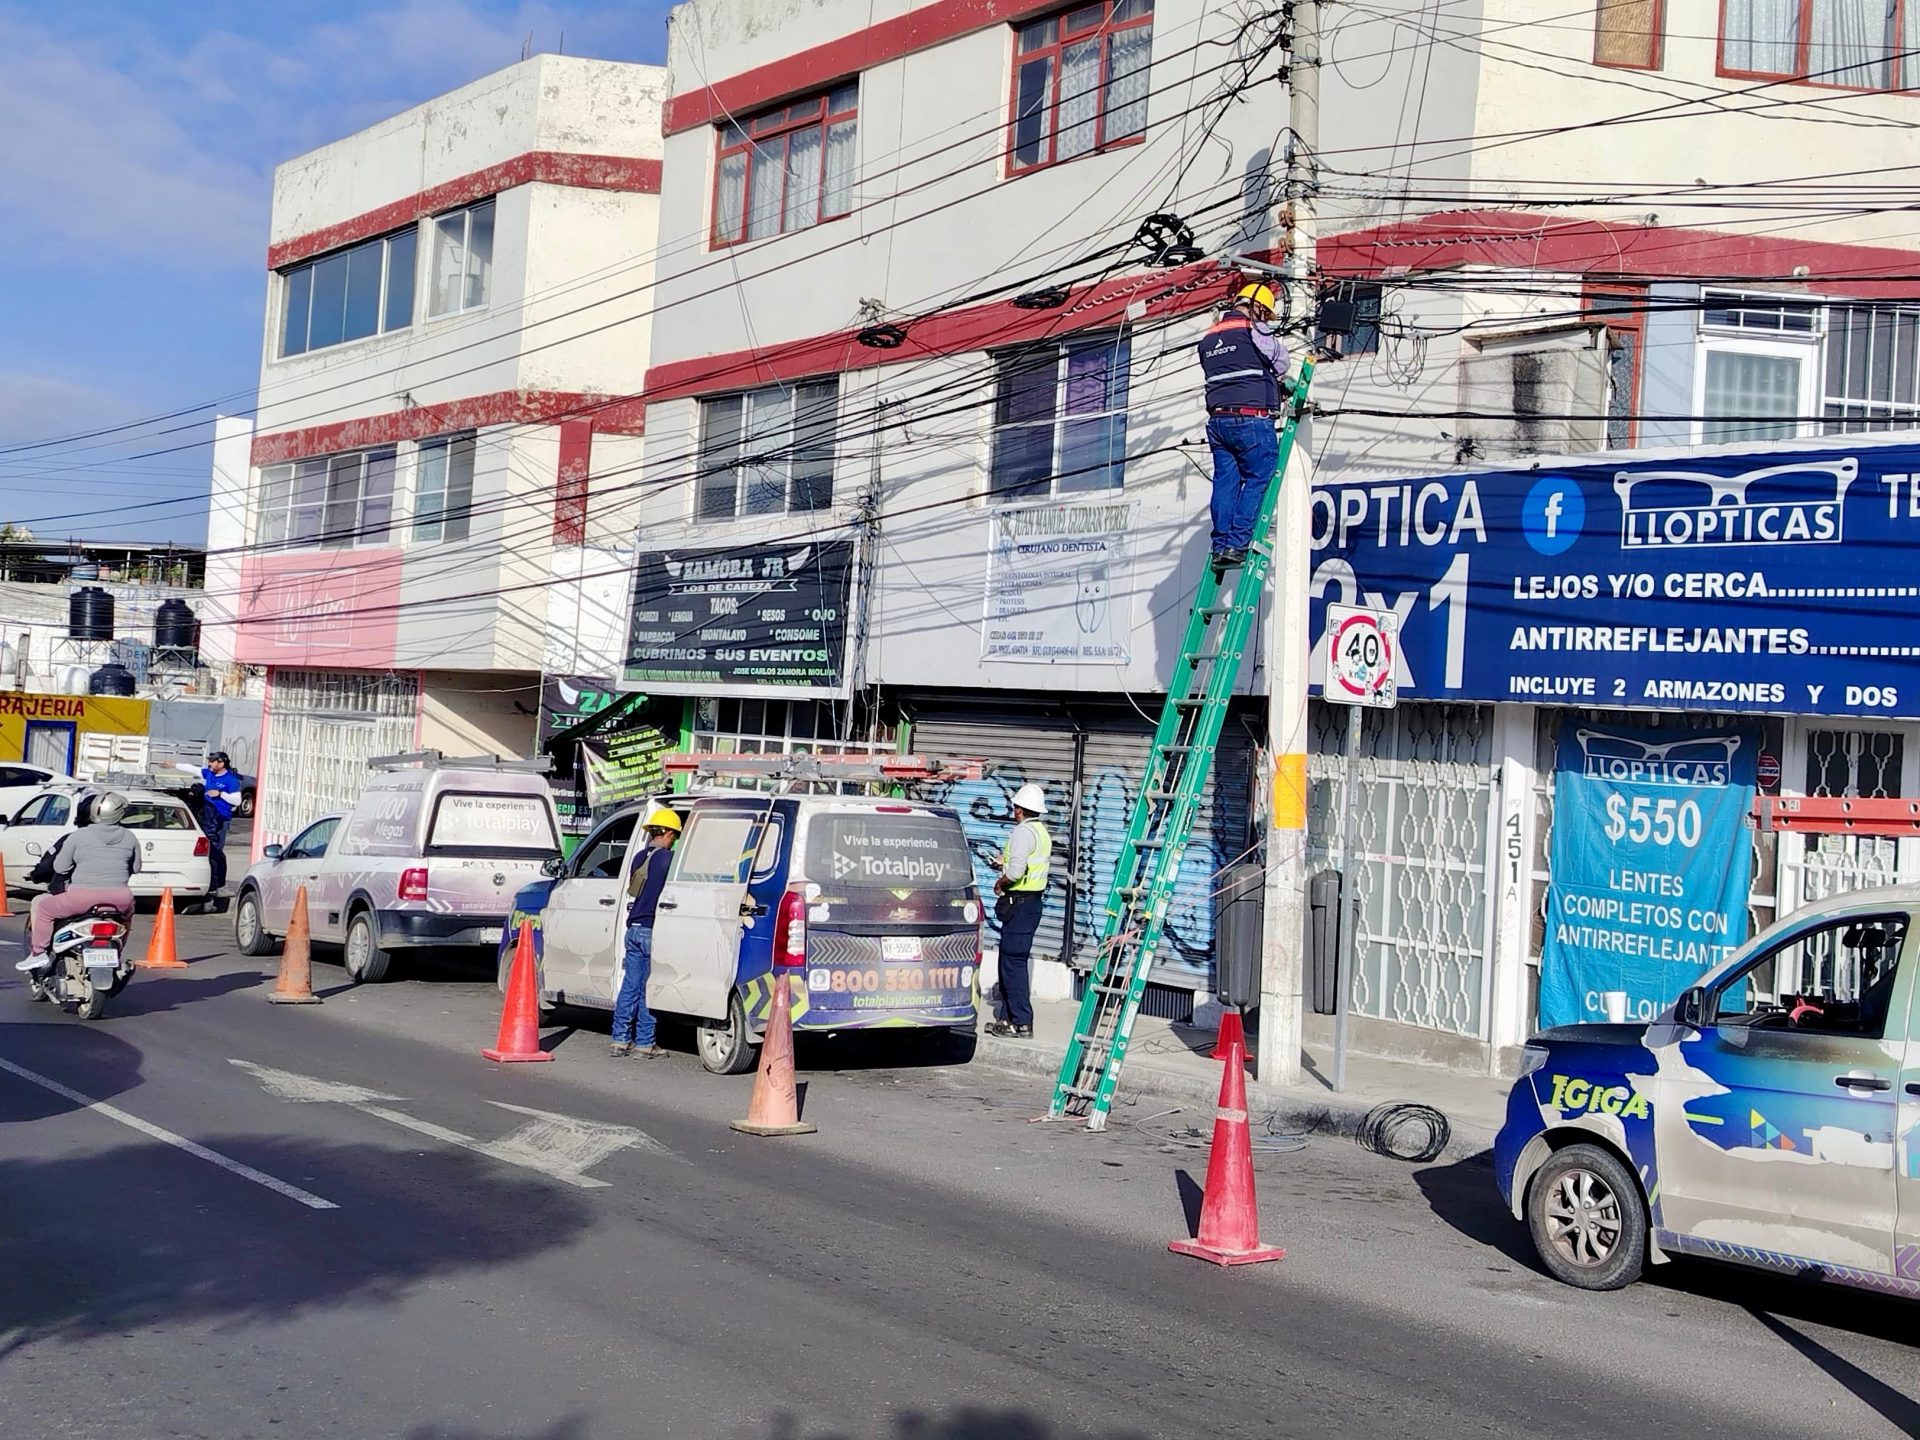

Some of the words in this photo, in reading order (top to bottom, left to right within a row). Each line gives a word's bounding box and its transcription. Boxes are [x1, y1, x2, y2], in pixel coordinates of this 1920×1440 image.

[1015, 510, 1036, 537] JUAN
[1036, 509, 1066, 536] MANUEL
[1067, 507, 1103, 534] GUZMAN
[1104, 504, 1130, 532] PEREZ
[1310, 480, 1488, 550] OPTICA
[1627, 505, 1836, 545] LLOPTICAS
[1017, 544, 1060, 554] CIRUJANO
[1061, 542, 1107, 553] DENTISTA
[682, 558, 754, 581] ZAMORA
[762, 557, 785, 578] JR
[682, 584, 706, 593] LOS
[707, 584, 723, 592] DE
[725, 582, 773, 592] CABEZA
[1513, 575, 1599, 600] LEJOS
[1608, 573, 1655, 598] Y/O
[638, 611, 660, 622] CABEZA
[671, 611, 694, 622] LENGUA
[761, 609, 786, 621] SESOS
[812, 609, 837, 621] OJO
[701, 629, 747, 641] MONTALAYO
[775, 629, 820, 641] CONSOME
[633, 648, 707, 660] CUBRIMOS
[714, 649, 746, 661] SUS
[749, 649, 829, 662] EVENTOS
[1345, 633, 1379, 668] 40
[750, 668, 776, 676] CARLOS
[776, 668, 807, 676] ZAMORA
[808, 669, 837, 677] MOLINA
[1510, 676, 1596, 696] INCLUYE
[1613, 678, 1627, 697] 2
[1644, 679, 1786, 703] ARMAZONES
[1807, 685, 1824, 704] Y
[1845, 686, 1899, 707] DOS
[1586, 756, 1726, 786] LLOPTICAS
[453, 799, 473, 810] Vive
[475, 800, 484, 810] la
[485, 800, 536, 812] experiencia
[556, 803, 576, 814] ECIO
[374, 822, 405, 840] Megas
[464, 810, 541, 835] Totalplay
[573, 816, 592, 827] JUAN
[1604, 791, 1702, 848] $550
[843, 834, 869, 847] Vive
[871, 835, 881, 847] la
[882, 836, 939, 850] experiencia
[860, 856, 945, 882] Totalplay
[1609, 868, 1684, 898] LENTES
[1564, 894, 1682, 930] COMPLETOS
[1687, 909, 1728, 935] CON
[831, 969, 879, 992] 800
[884, 968, 924, 992] 330
[928, 967, 960, 990] 1111
[853, 993, 943, 1009] totalplay.com.mx
